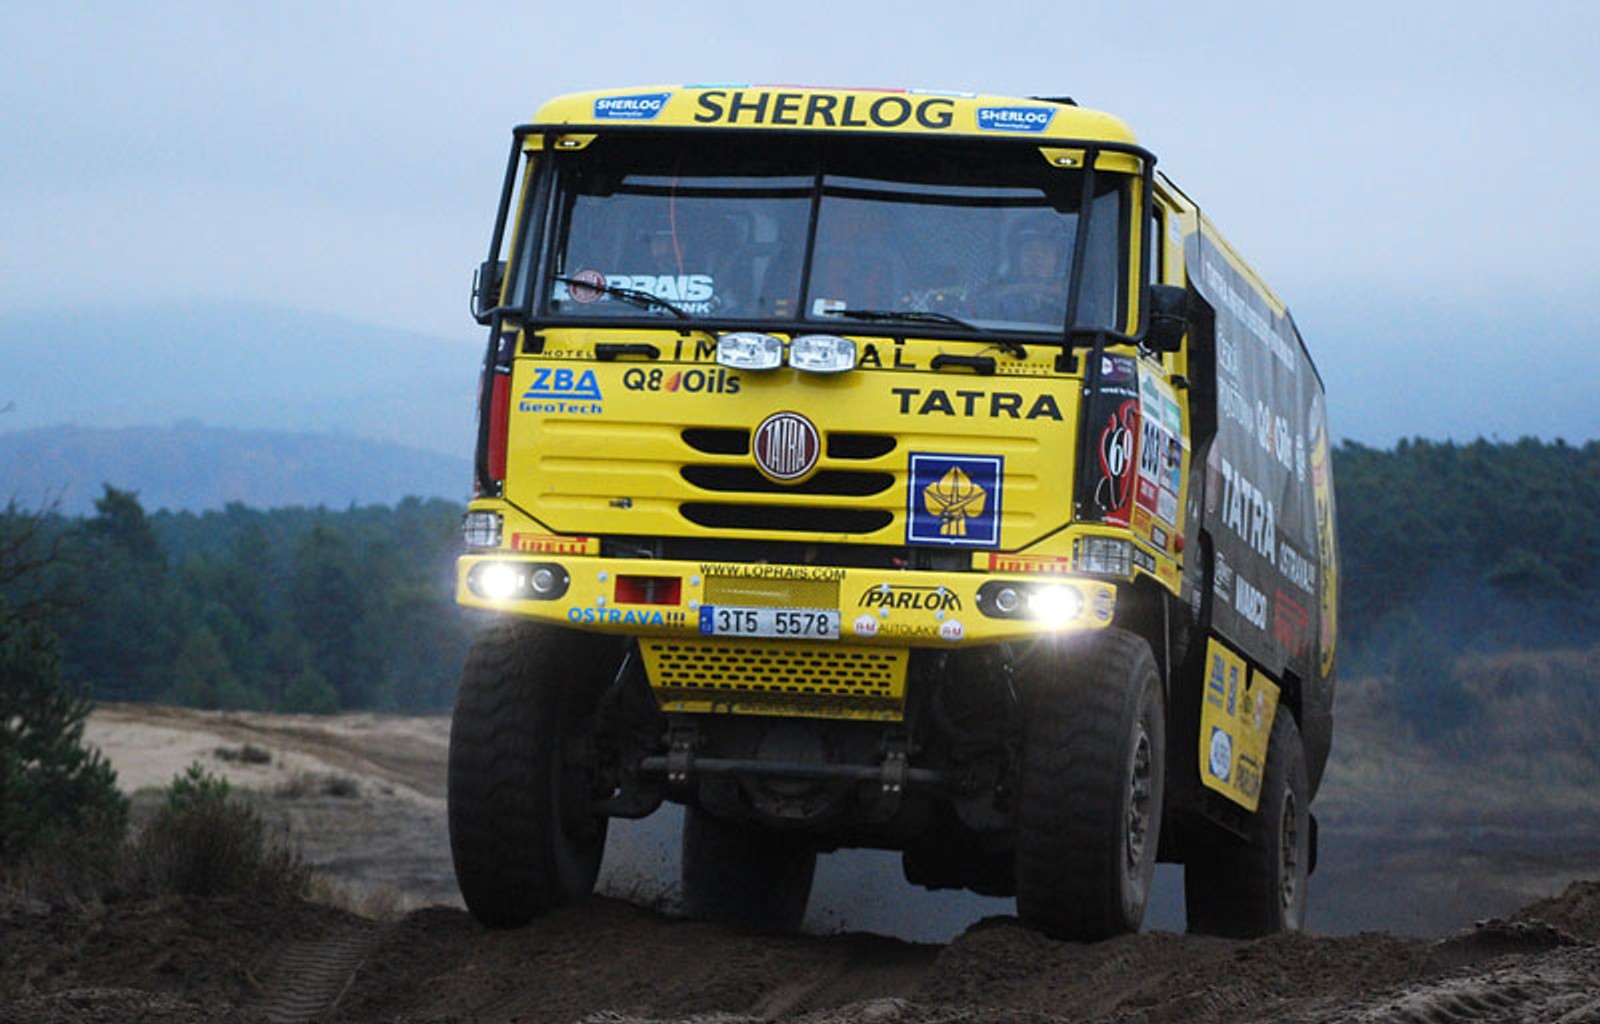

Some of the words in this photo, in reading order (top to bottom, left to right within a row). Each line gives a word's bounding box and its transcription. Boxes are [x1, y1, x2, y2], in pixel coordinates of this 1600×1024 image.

[597, 98, 661, 110] SHERLOG
[694, 91, 955, 129] SHERLOG
[980, 110, 1048, 124] SHERLOG
[543, 349, 595, 359] HOTEL
[524, 367, 603, 400] ZBA
[891, 387, 1064, 421] TATRA
[765, 418, 806, 473] TATRA
[1221, 457, 1276, 566] TATRA
[700, 563, 846, 581] WWW.LOPRAIS.COM
[865, 591, 956, 611] PARLOK
[717, 609, 759, 634] 3T5
[775, 611, 830, 636] 5578
